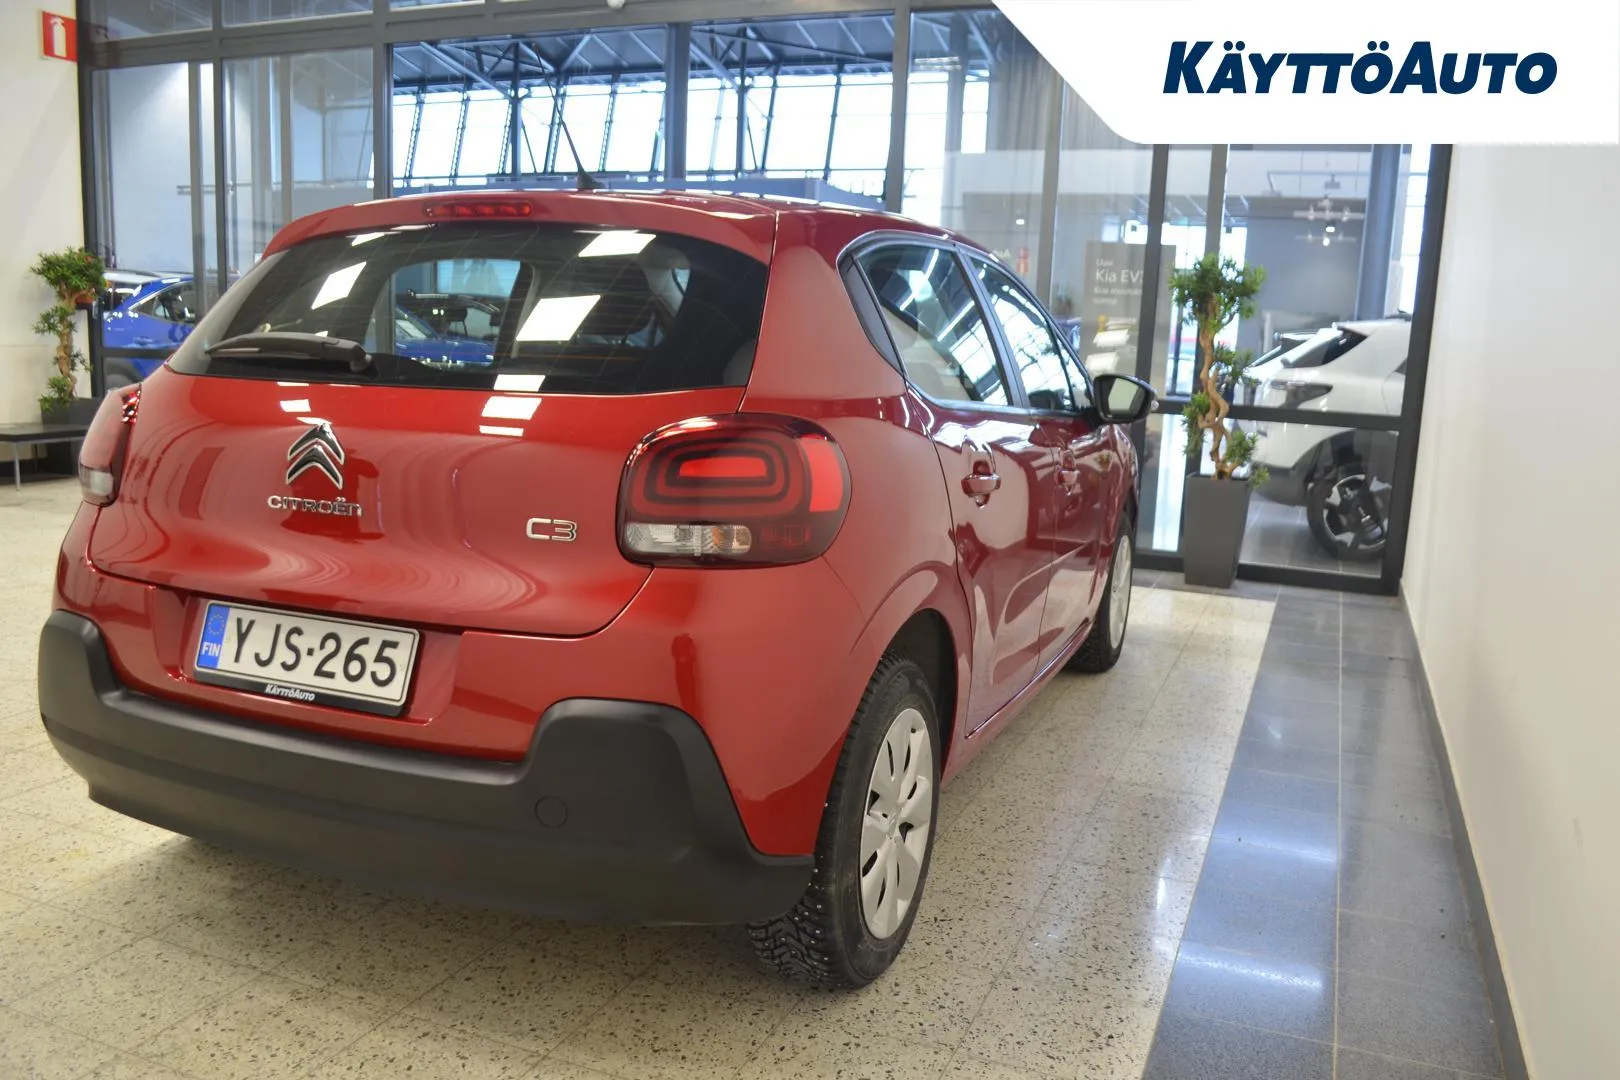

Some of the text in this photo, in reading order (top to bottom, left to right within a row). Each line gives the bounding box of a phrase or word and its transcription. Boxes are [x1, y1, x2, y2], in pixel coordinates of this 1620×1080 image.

[1095, 268, 1117, 282] Kia
[526, 517, 578, 542] C3
[201, 641, 221, 657] FIN
